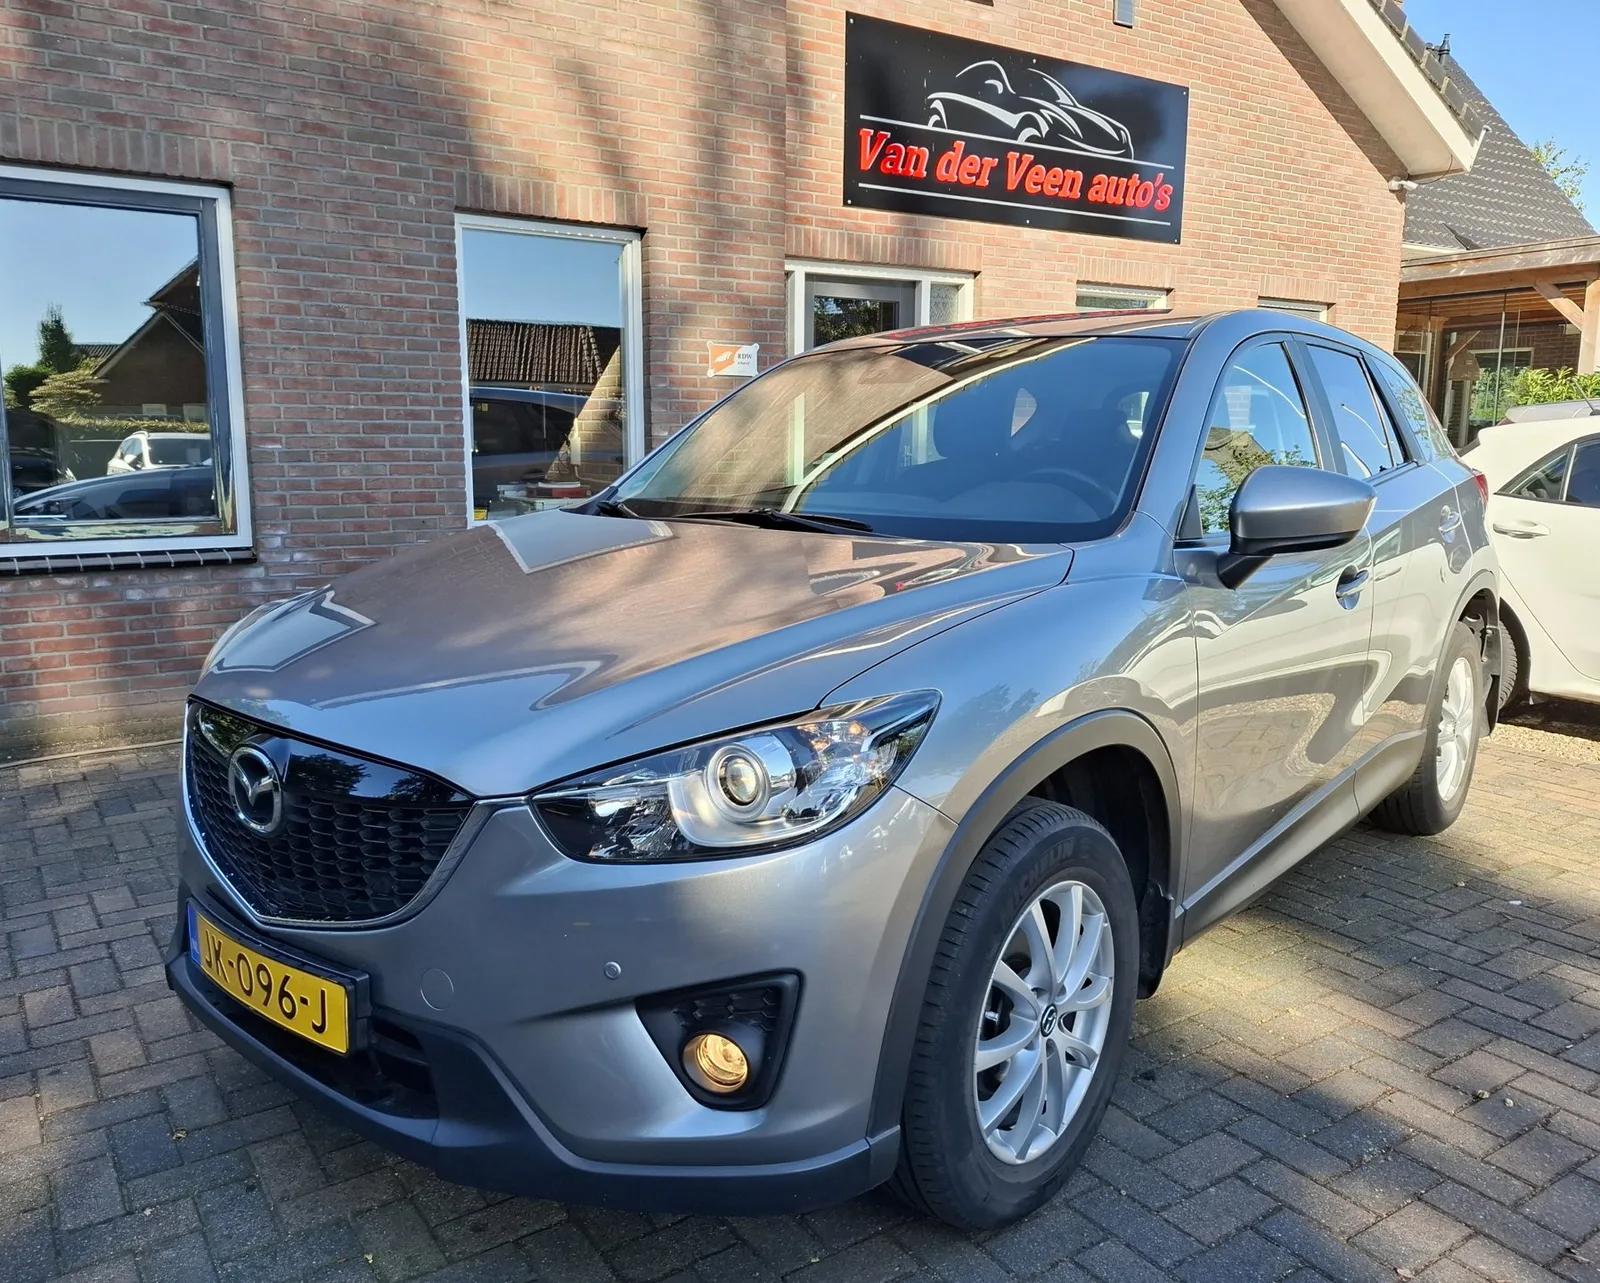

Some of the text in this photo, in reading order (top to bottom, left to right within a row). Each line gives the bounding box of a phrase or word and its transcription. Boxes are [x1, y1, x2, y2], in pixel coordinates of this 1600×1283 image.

[857, 128, 1174, 212] Van der Veen auto's
[205, 929, 327, 1034] JK-096-J
